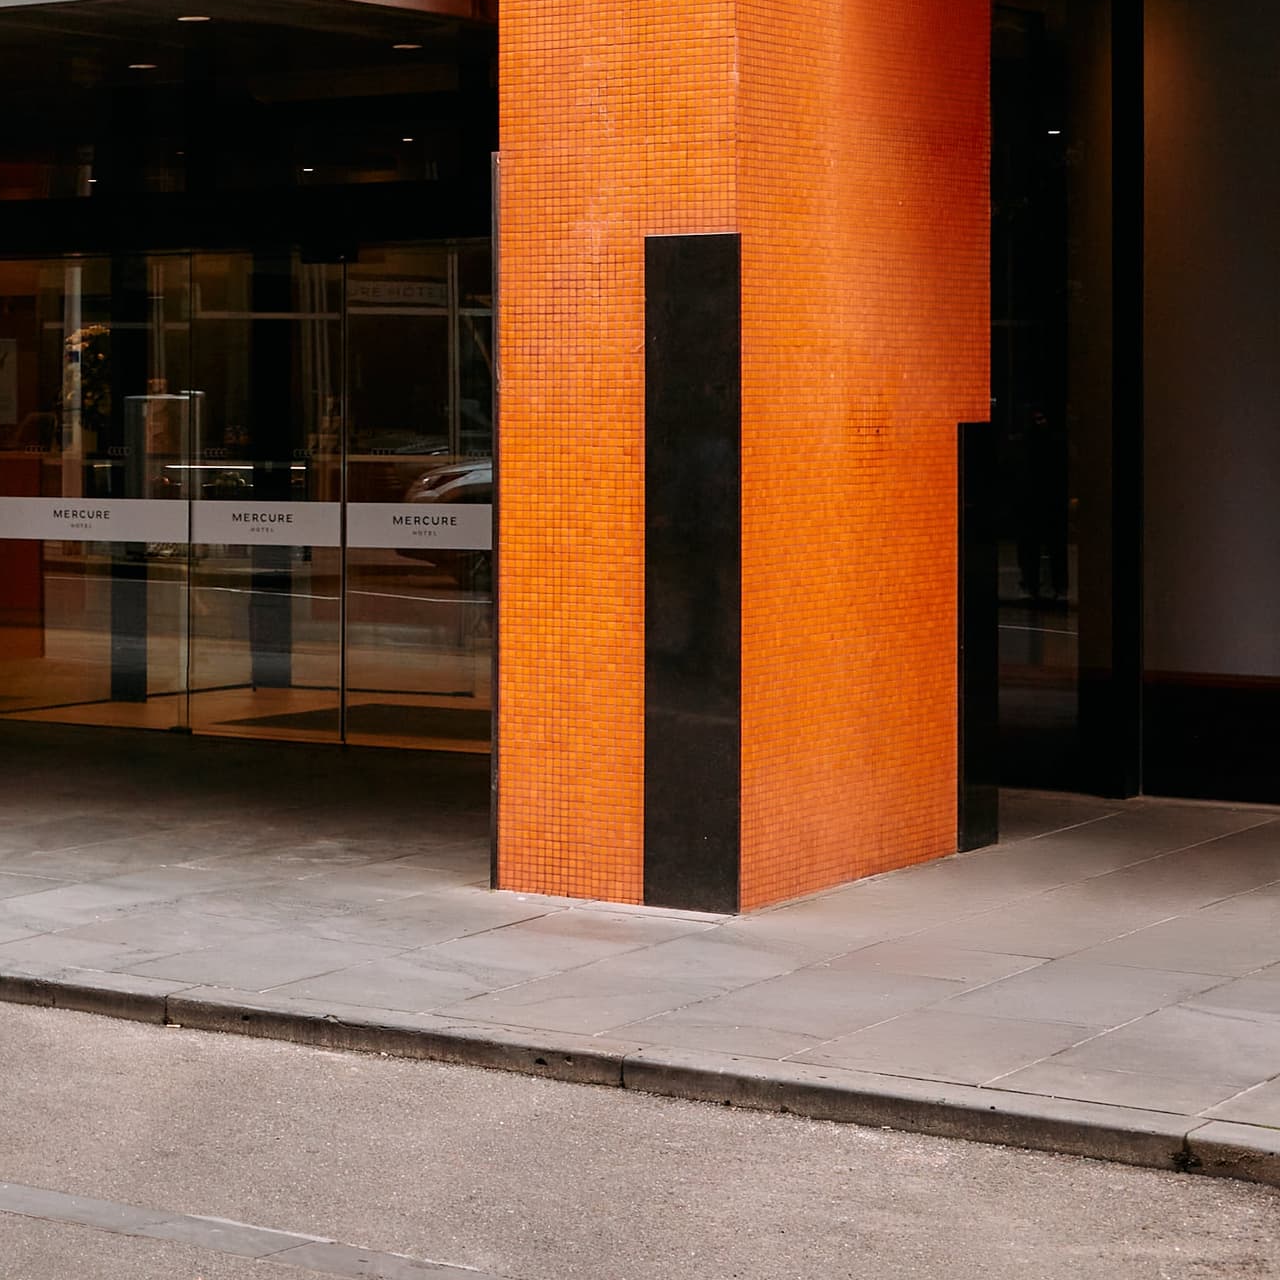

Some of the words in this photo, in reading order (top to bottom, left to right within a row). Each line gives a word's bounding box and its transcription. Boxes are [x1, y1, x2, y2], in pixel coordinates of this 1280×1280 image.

[52, 509, 111, 520] MERCURE
[231, 512, 294, 524] MERCURE
[392, 515, 457, 526] MERCURE
